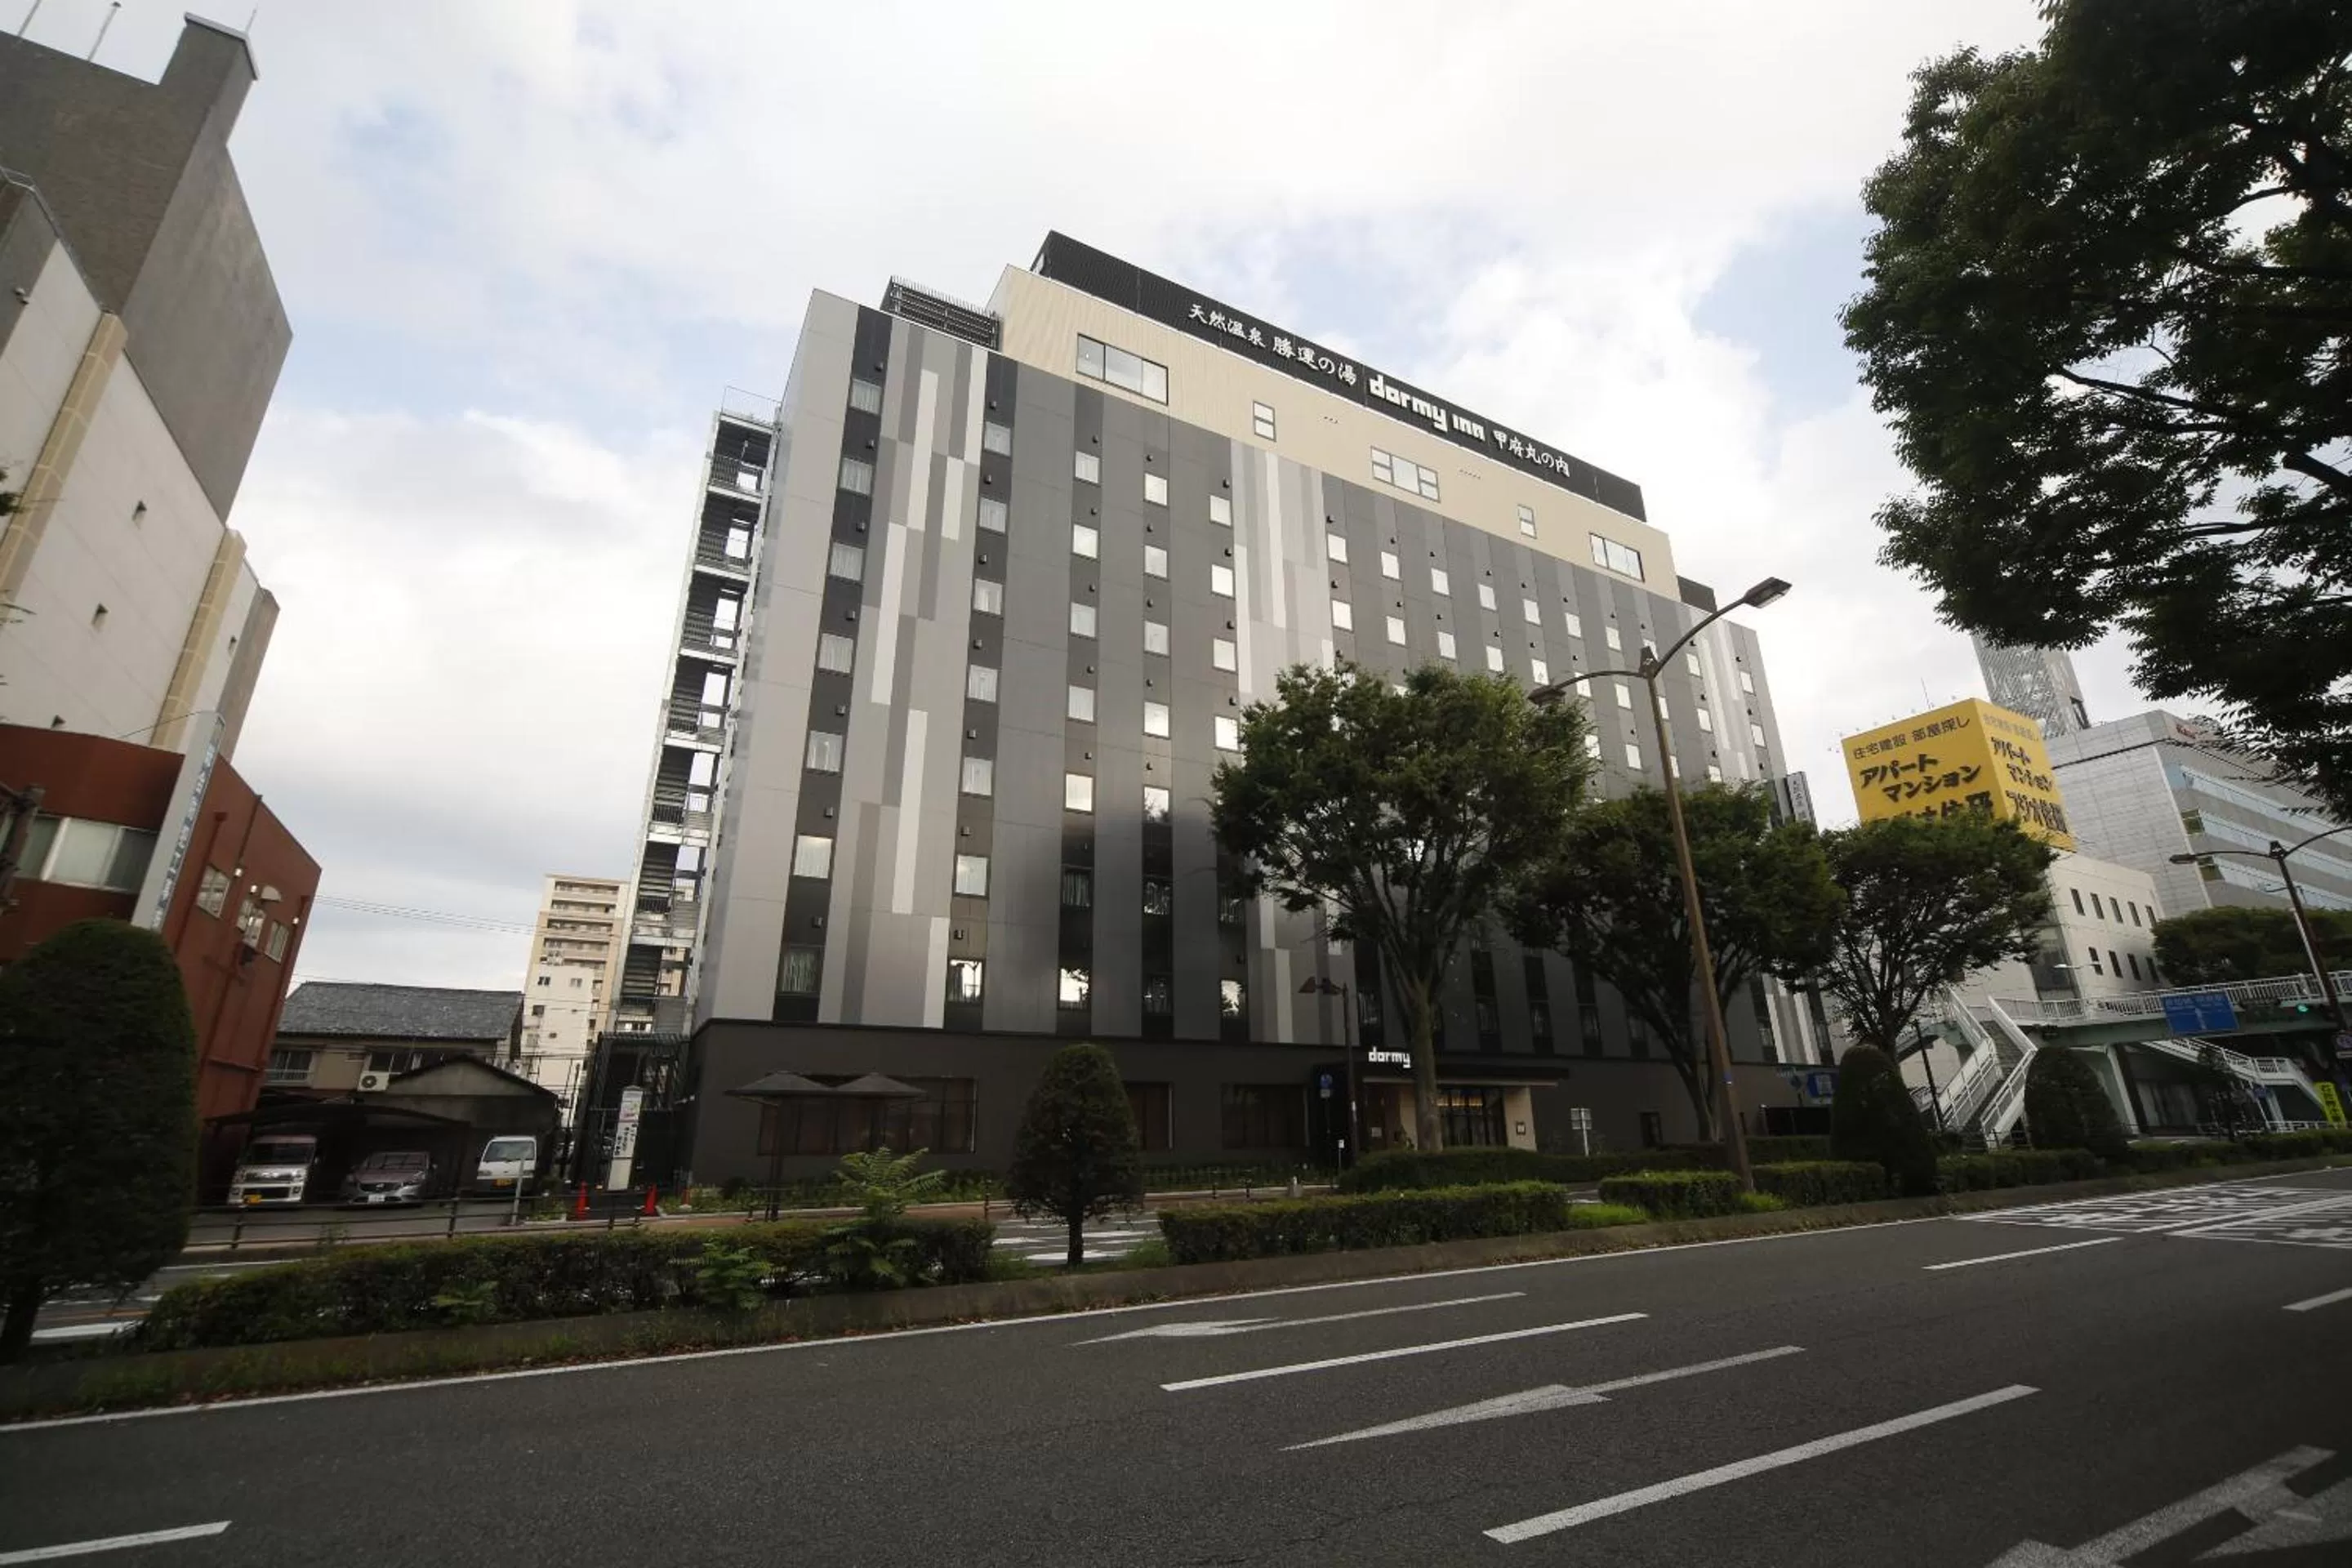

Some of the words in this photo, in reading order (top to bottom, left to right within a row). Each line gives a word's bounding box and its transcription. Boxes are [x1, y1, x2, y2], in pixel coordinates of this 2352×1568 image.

[1188, 303, 1266, 348] 天然温泉
[1272, 336, 1356, 387] 勝運の湯
[1369, 375, 1448, 433] dormy
[1452, 412, 1486, 442] inn
[1492, 430, 1570, 478] 甲府丸の内
[1860, 753, 1939, 789] アパート
[1882, 764, 1981, 803] マンション
[1368, 1046, 1411, 1069] dormy
